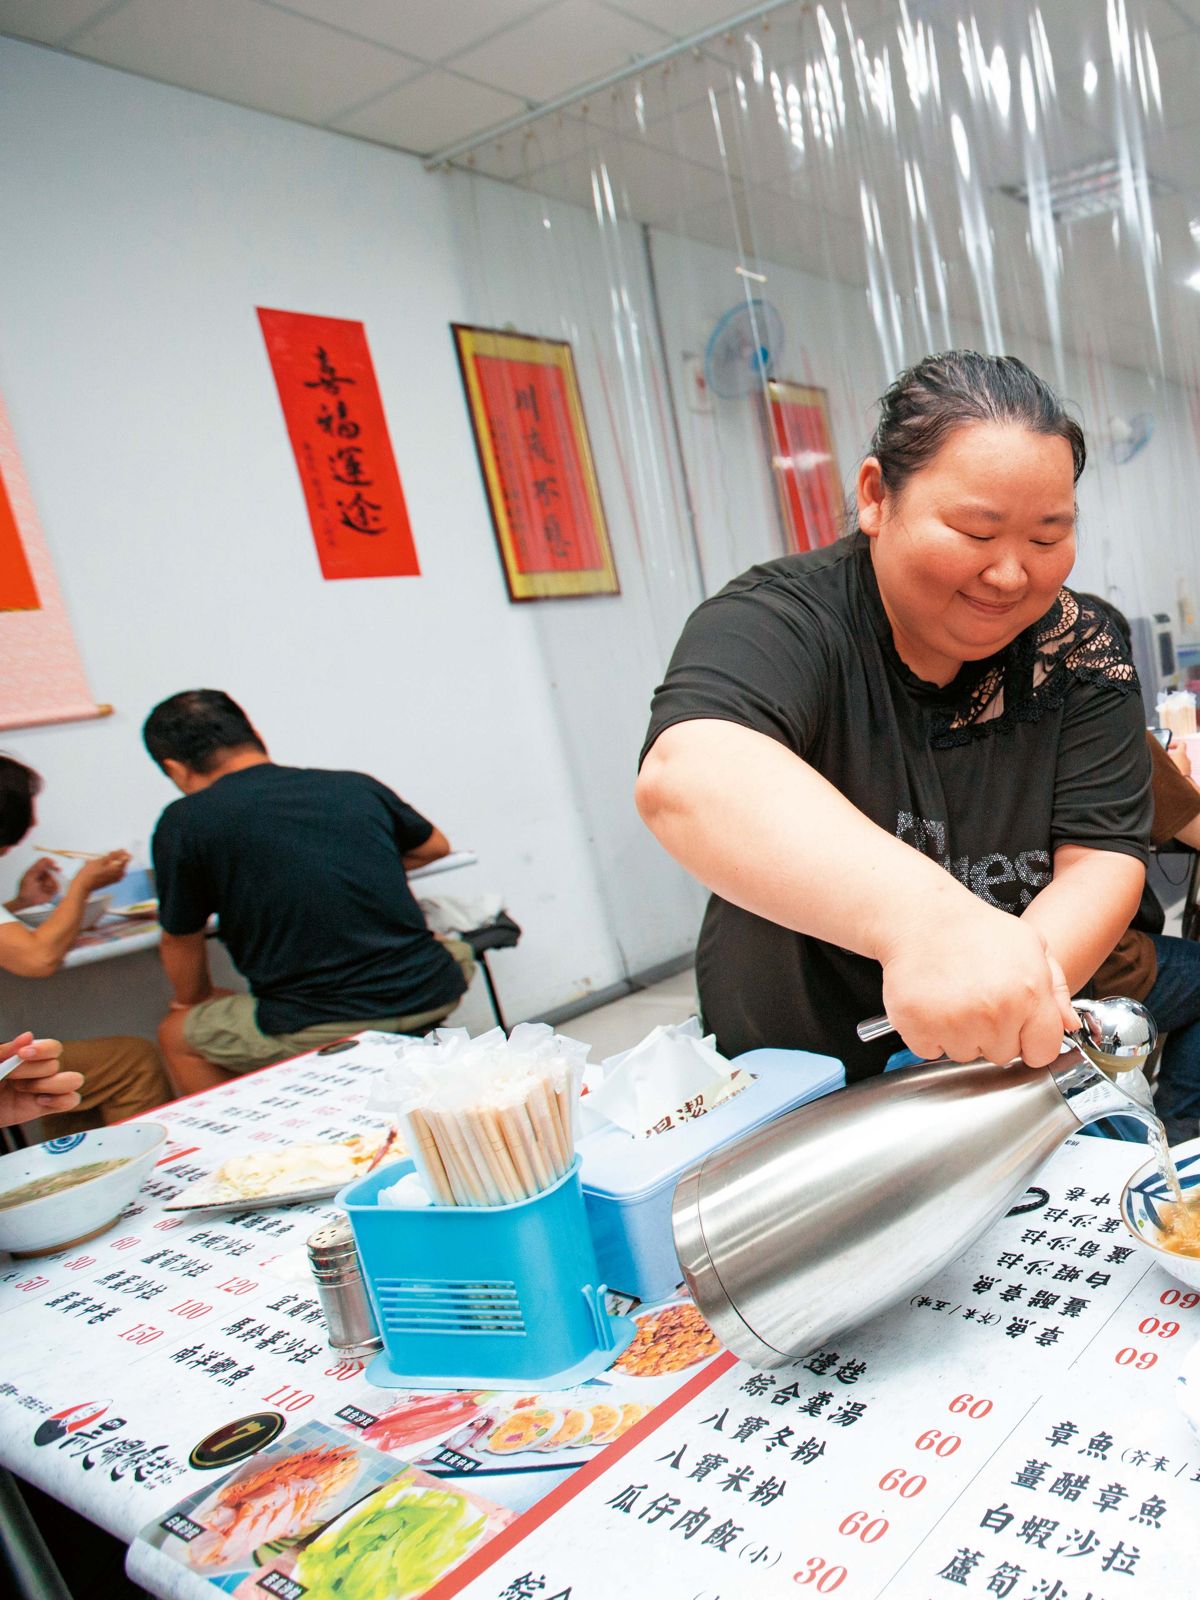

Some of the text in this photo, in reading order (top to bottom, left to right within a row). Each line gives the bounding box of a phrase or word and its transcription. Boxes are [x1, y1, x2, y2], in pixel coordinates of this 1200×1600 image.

[153, 1217, 185, 1231] 60
[1043, 1206, 1133, 1238] 蛋沙拉
[110, 1236, 142, 1251] 60
[187, 1230, 257, 1257] 白蝦沙拉
[1020, 1228, 1137, 1265] 蘆筍沙拉
[63, 1255, 98, 1272] 30
[997, 1251, 1112, 1289] 白蝦沙拉
[14, 1275, 50, 1293] 50
[216, 1276, 260, 1296] 120
[972, 1273, 1092, 1318] 薑醋章魚
[1159, 1289, 1200, 1309] 60
[168, 1299, 213, 1320] 100
[118, 1323, 165, 1346] 150
[221, 1317, 323, 1364] 馬鈴薯沙拉
[1138, 1317, 1180, 1338] 60
[792, 1352, 867, 1385] 邊趖
[1115, 1347, 1158, 1370] 60
[262, 1384, 315, 1412] 110
[739, 1373, 868, 1427] 綜合羹湯
[948, 1393, 994, 1419] 60
[699, 1406, 827, 1465] 八寶冬粉
[915, 1429, 962, 1457] 60
[655, 1444, 787, 1507] 八寶米粉
[878, 1468, 928, 1499] 60
[1010, 1459, 1168, 1529] 薑醋章魚
[838, 1511, 890, 1544] 60
[979, 1503, 1141, 1576] 白蝦沙拉
[793, 1556, 848, 1594] 30
[935, 1547, 1114, 1600] 蘆筍沙
